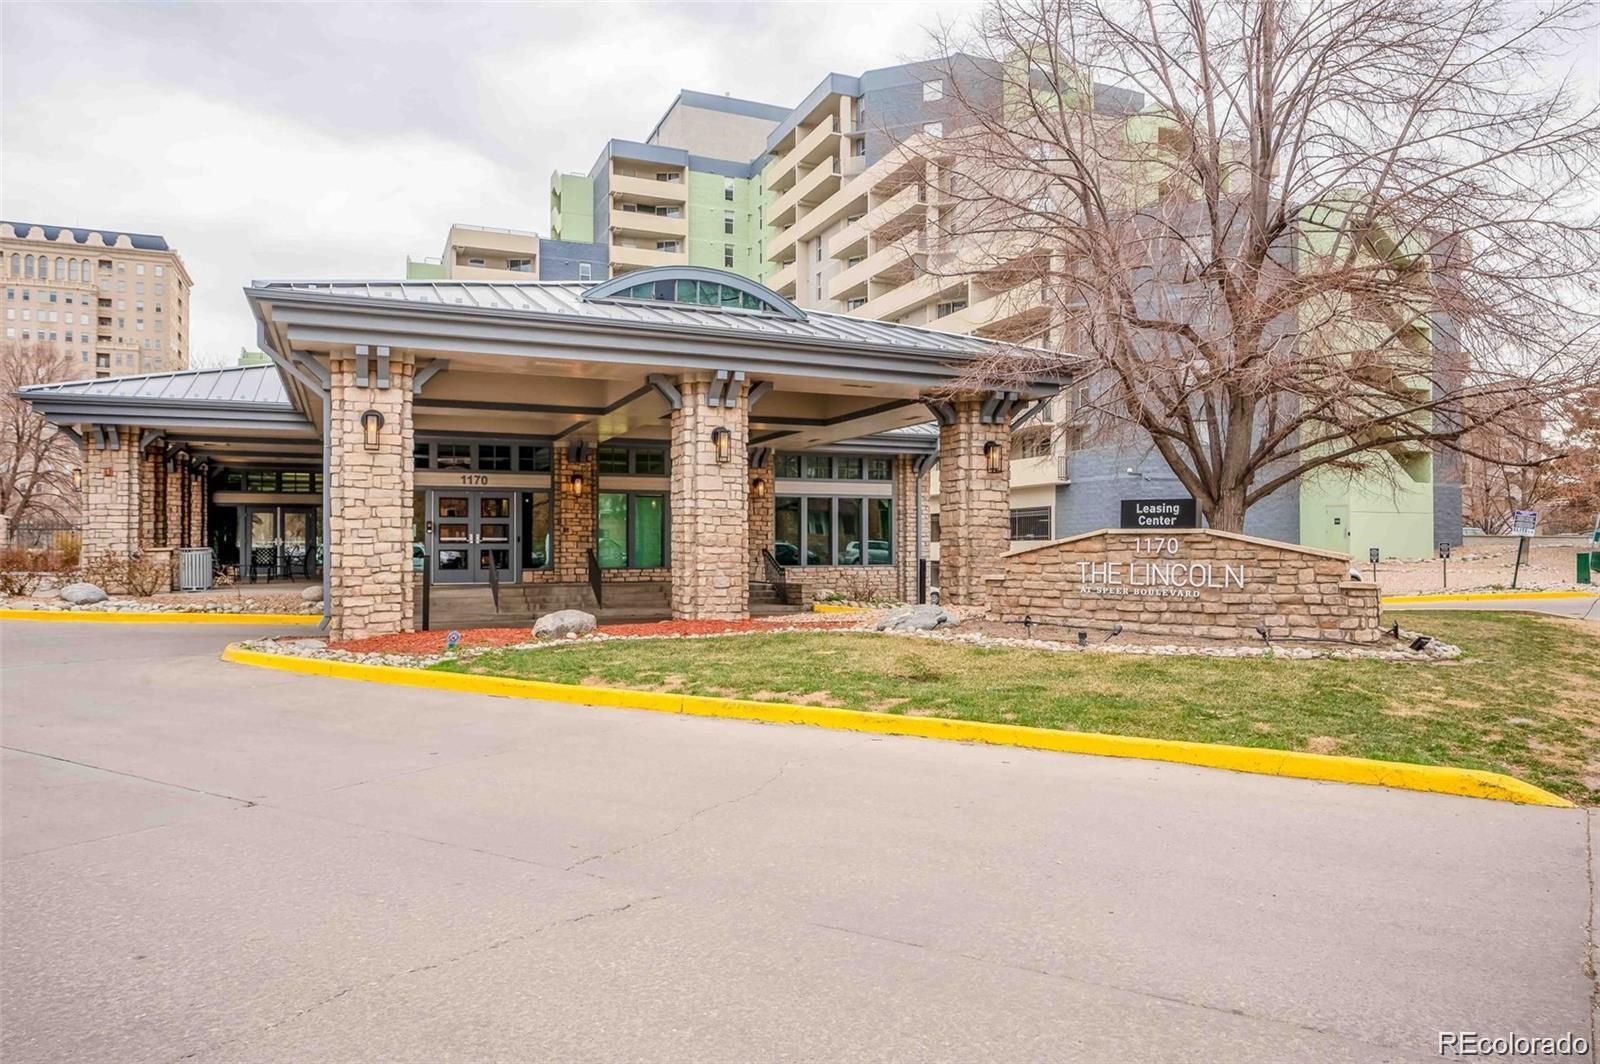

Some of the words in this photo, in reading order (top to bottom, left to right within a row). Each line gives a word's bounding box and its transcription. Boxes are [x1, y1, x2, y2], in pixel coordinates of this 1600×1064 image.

[461, 475, 488, 485] 1170
[1136, 503, 1180, 516] Leasing
[1138, 515, 1176, 526] Center
[1134, 537, 1179, 554] 1170
[1076, 561, 1122, 584] THE
[1130, 562, 1244, 589] LINCOLN
[1080, 586, 1093, 594] AT
[1096, 587, 1129, 595] SPEER
[1134, 588, 1201, 598] BOULEVARD
